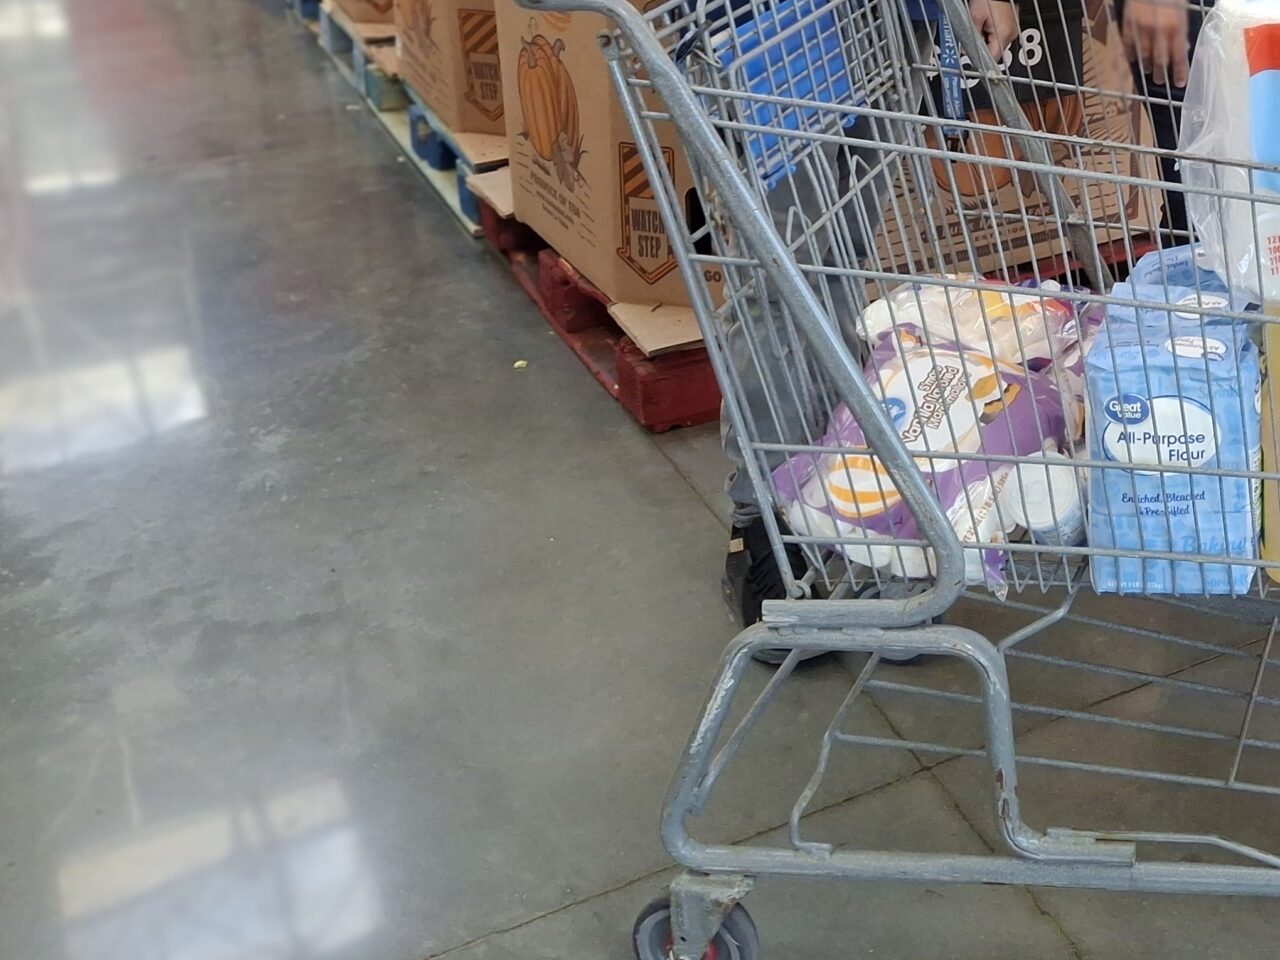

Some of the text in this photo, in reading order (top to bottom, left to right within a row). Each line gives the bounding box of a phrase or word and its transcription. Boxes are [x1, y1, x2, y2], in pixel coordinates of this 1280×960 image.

[638, 235, 661, 259] STEP
[1267, 235, 1277, 245] 12
[1116, 431, 1206, 448] All-Purpose
[1168, 448, 1206, 462] Flour
[1121, 491, 1163, 504] Eniched,
